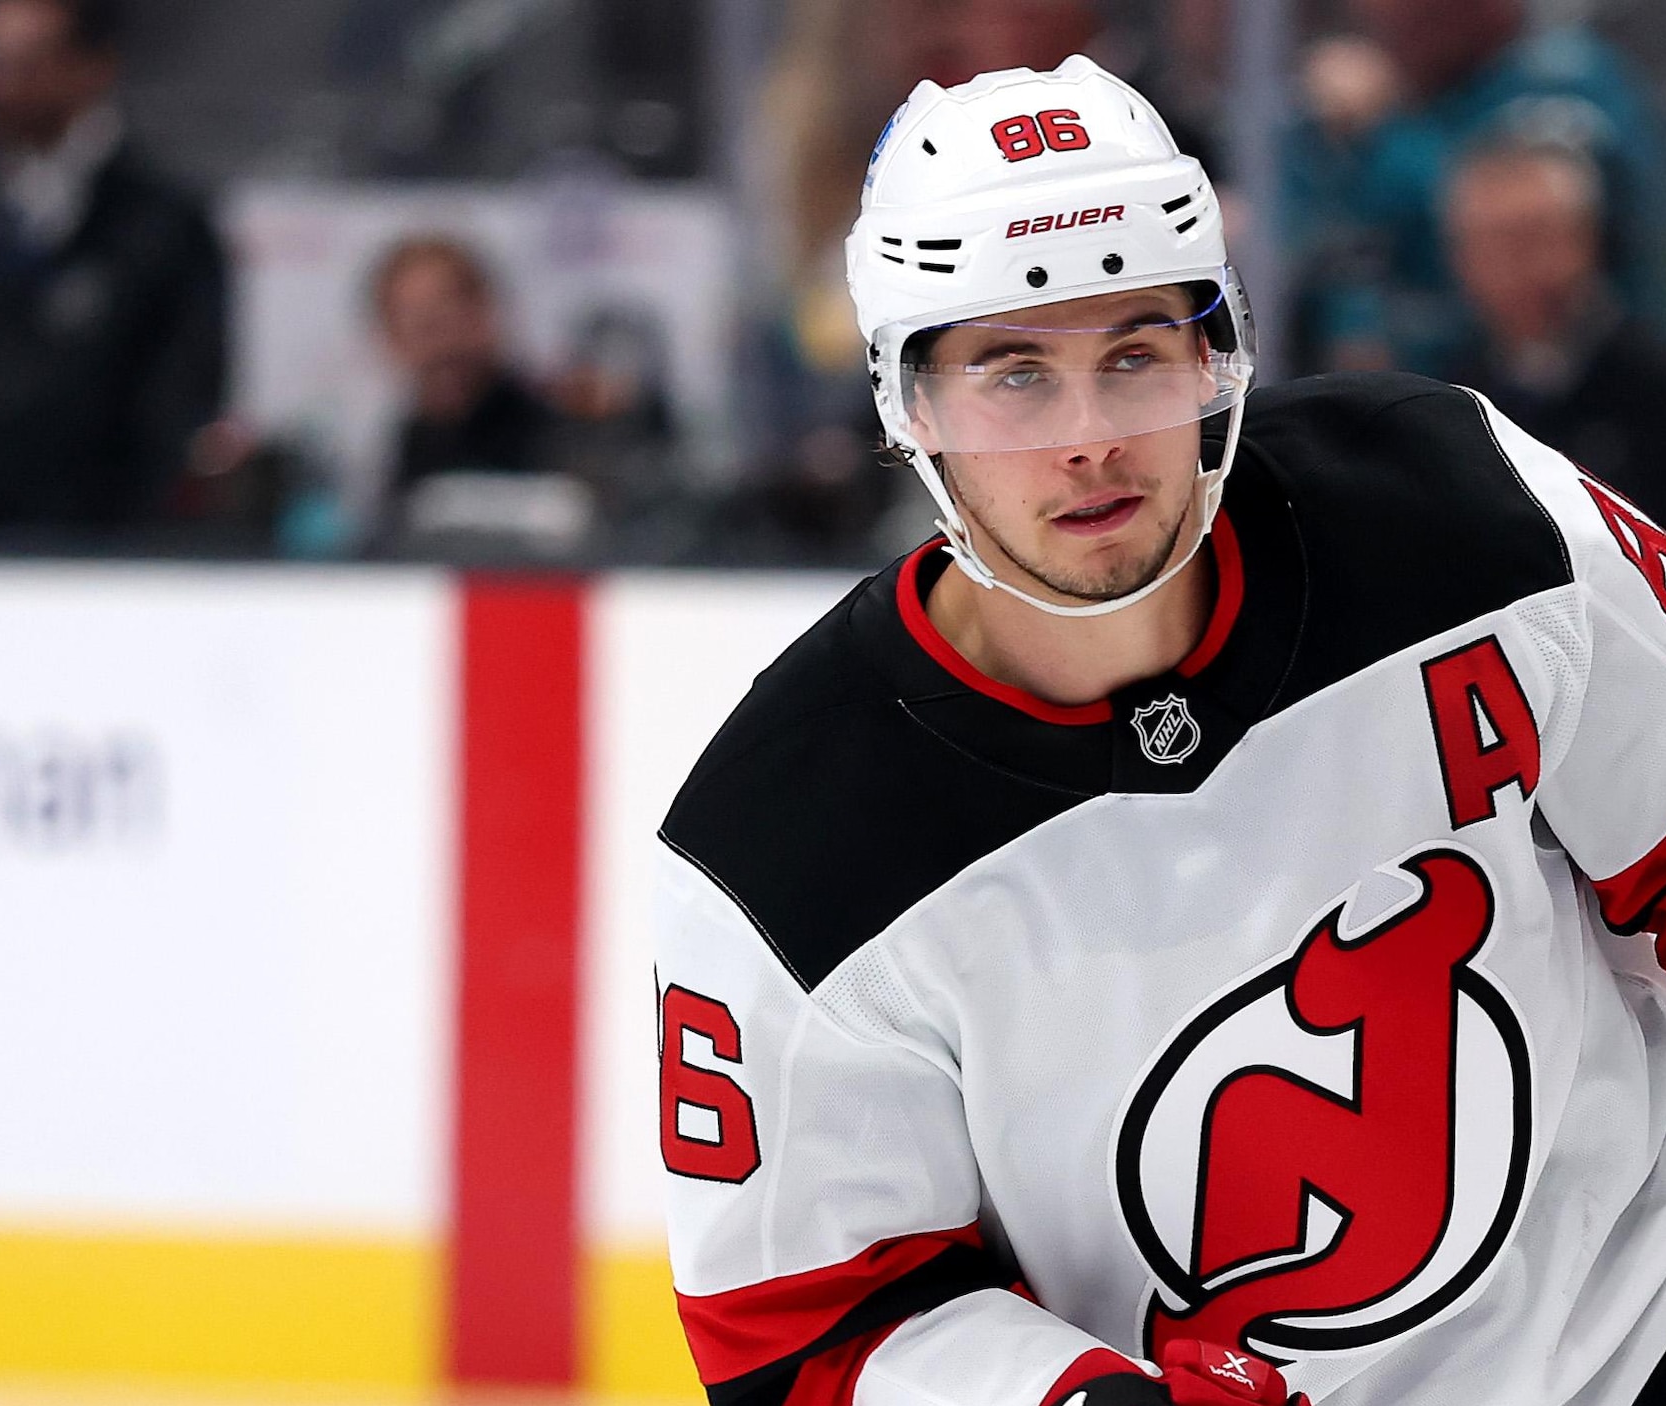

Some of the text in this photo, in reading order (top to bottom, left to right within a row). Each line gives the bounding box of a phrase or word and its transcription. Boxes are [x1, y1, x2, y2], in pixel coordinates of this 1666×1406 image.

[989, 108, 1092, 163] 86
[1005, 204, 1126, 239] BAUER
[1153, 712, 1182, 753] NHL
[1419, 632, 1542, 832] A
